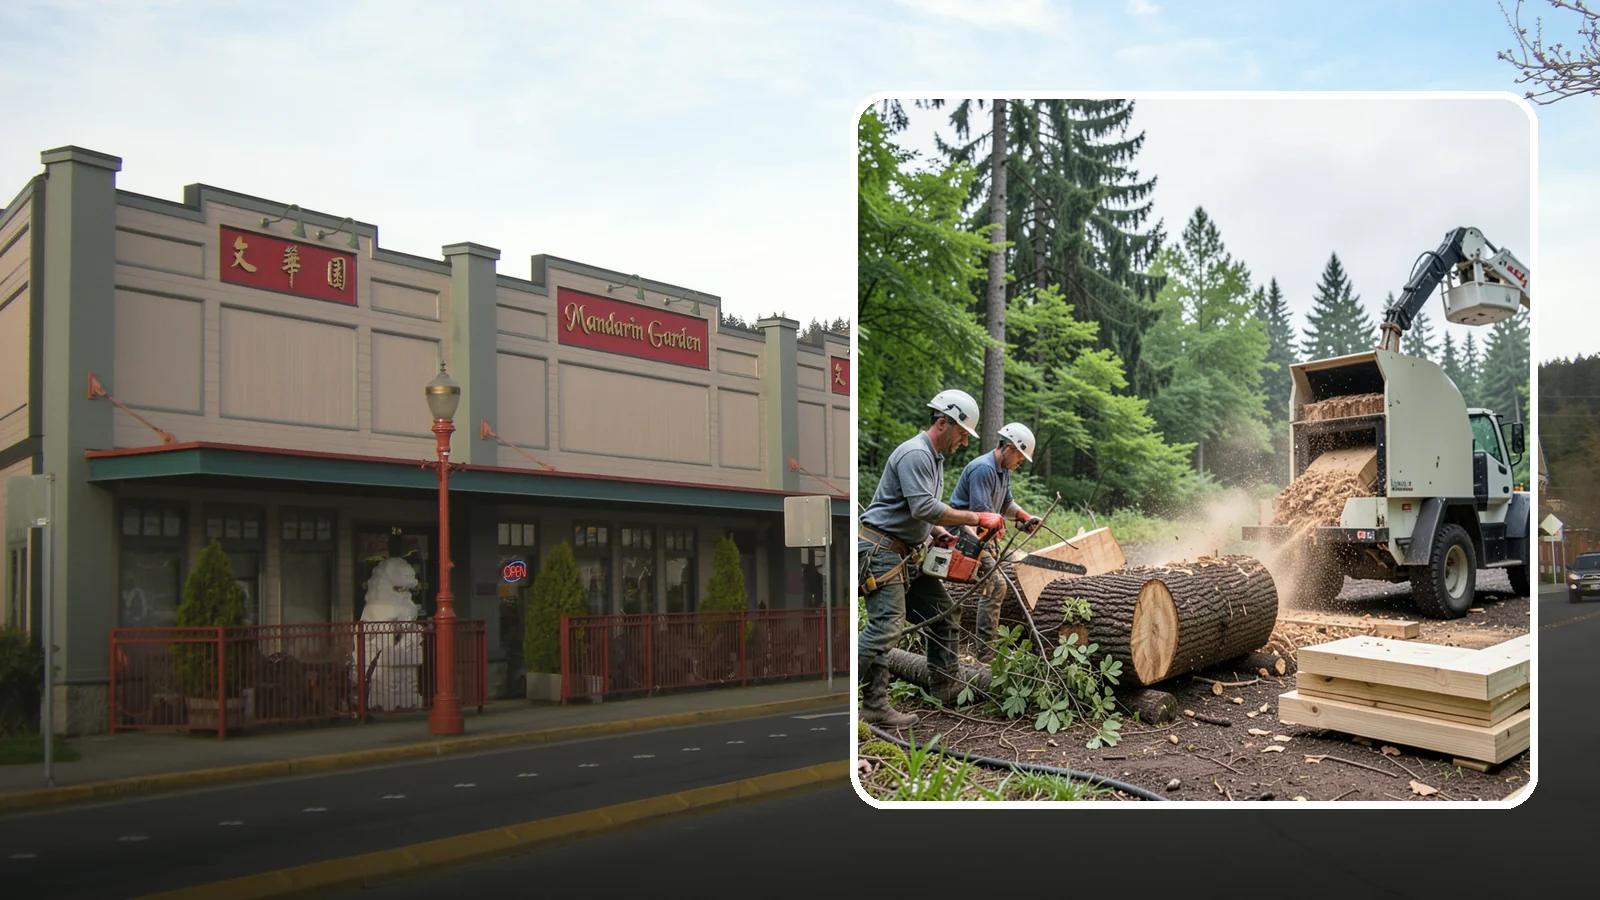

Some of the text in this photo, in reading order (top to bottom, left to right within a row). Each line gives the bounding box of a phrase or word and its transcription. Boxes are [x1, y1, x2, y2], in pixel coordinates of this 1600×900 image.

[231, 235, 346, 291] 文華園
[564, 302, 701, 352] Mandarin Garden
[503, 565, 527, 578] OPEN
